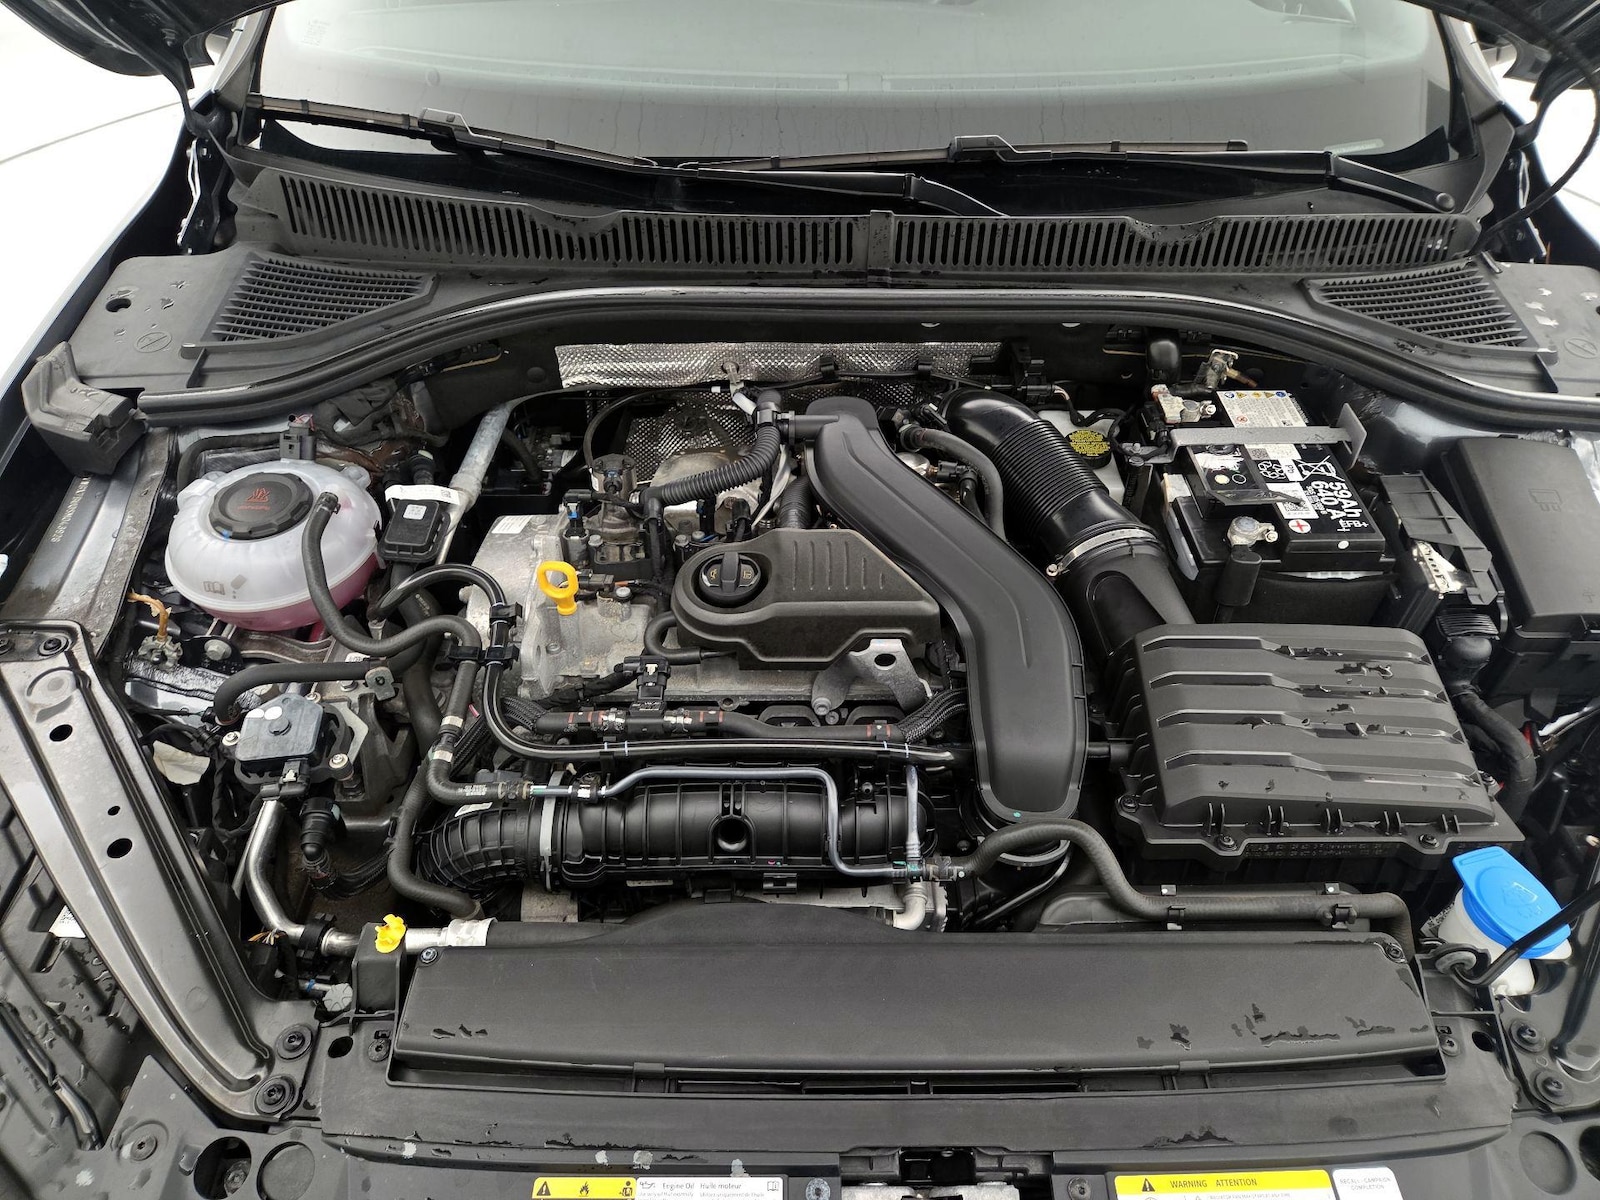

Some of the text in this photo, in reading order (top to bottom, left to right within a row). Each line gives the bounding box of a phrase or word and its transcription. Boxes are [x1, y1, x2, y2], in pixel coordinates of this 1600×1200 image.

[1311, 480, 1337, 506] 640
[1326, 508, 1347, 520] A
[1328, 481, 1362, 518] 59Ah
[662, 1182, 695, 1192] Engine Oil
[700, 1182, 742, 1190] Huile moteur
[1170, 1178, 1258, 1188] WARNING ATTENTION
